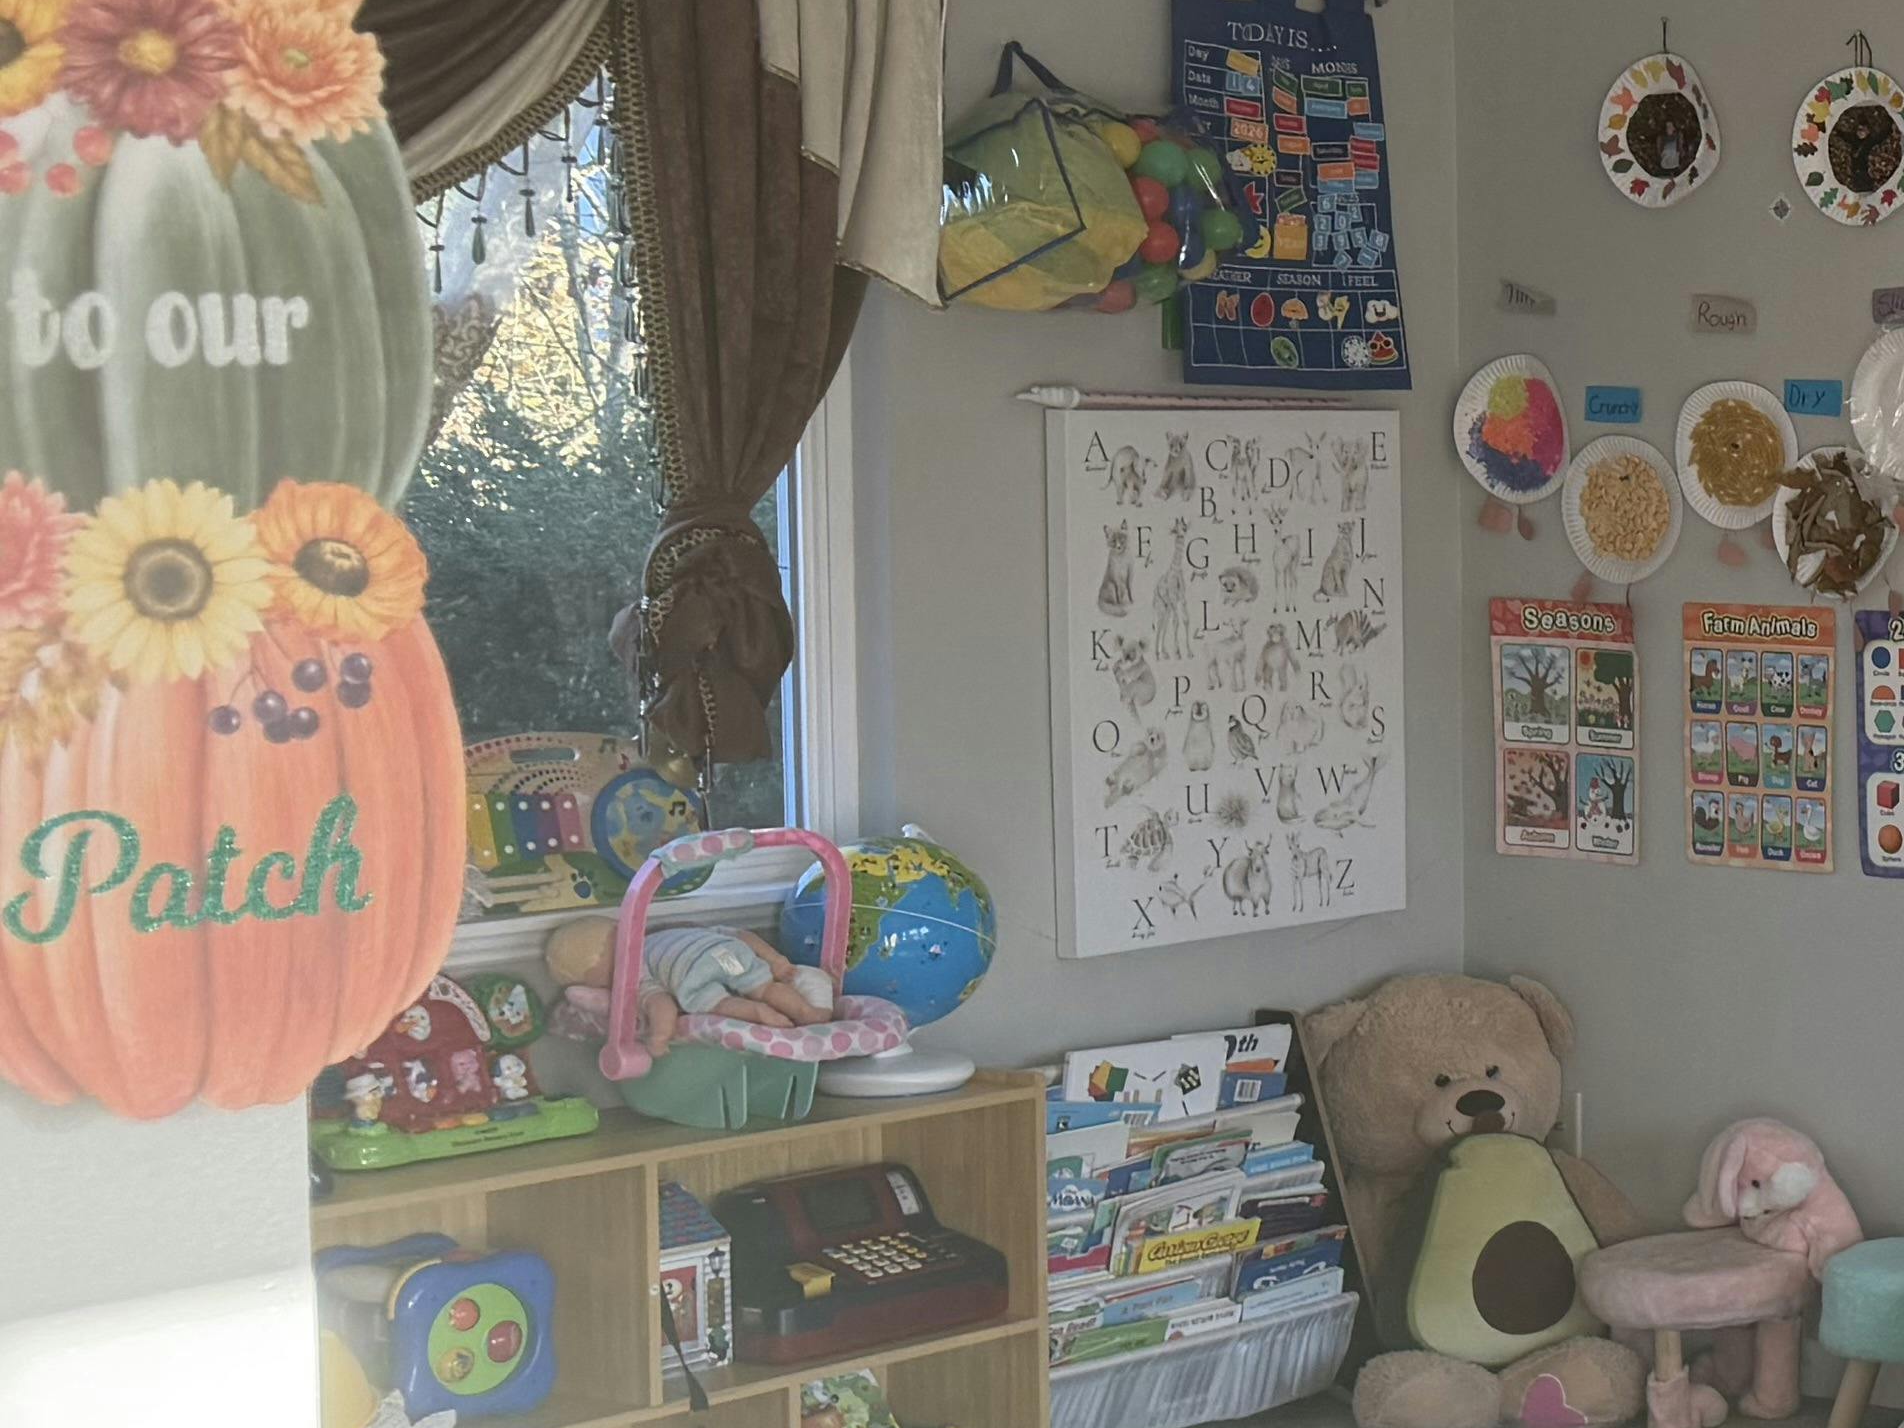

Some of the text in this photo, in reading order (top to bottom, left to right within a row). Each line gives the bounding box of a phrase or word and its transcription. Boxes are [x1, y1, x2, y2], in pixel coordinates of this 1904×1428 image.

[1188, 45, 1210, 61] Day
[7, 266, 310, 370] to our
[1698, 300, 1747, 331] Rough
[1789, 384, 1826, 410] Dry
[1085, 431, 1109, 462] A
[1206, 439, 1228, 471] C
[1371, 431, 1386, 461] E
[1269, 457, 1290, 488] D
[1200, 487, 1217, 517] B
[1137, 526, 1152, 558] F
[1186, 537, 1209, 569] G
[1234, 524, 1256, 554] H
[1308, 528, 1313, 558] I
[1356, 517, 1366, 558] J
[1364, 578, 1383, 608] N
[1202, 600, 1219, 631] L
[1523, 608, 1615, 632] Seasons
[1703, 613, 1818, 638] Farm Animals
[1091, 629, 1111, 660] K
[1297, 619, 1321, 650] M
[1175, 676, 1190, 706] P
[1310, 670, 1331, 700] R
[1242, 694, 1268, 733] Q
[1371, 706, 1385, 737] S
[1093, 720, 1119, 752] O
[1255, 766, 1276, 796] V
[1317, 764, 1345, 795] W
[1185, 783, 1208, 815] U
[1095, 824, 1118, 857] T
[1207, 836, 1227, 868] Y
[3, 792, 374, 943] Patch
[1336, 858, 1355, 890] Z
[1131, 897, 1154, 930] X
